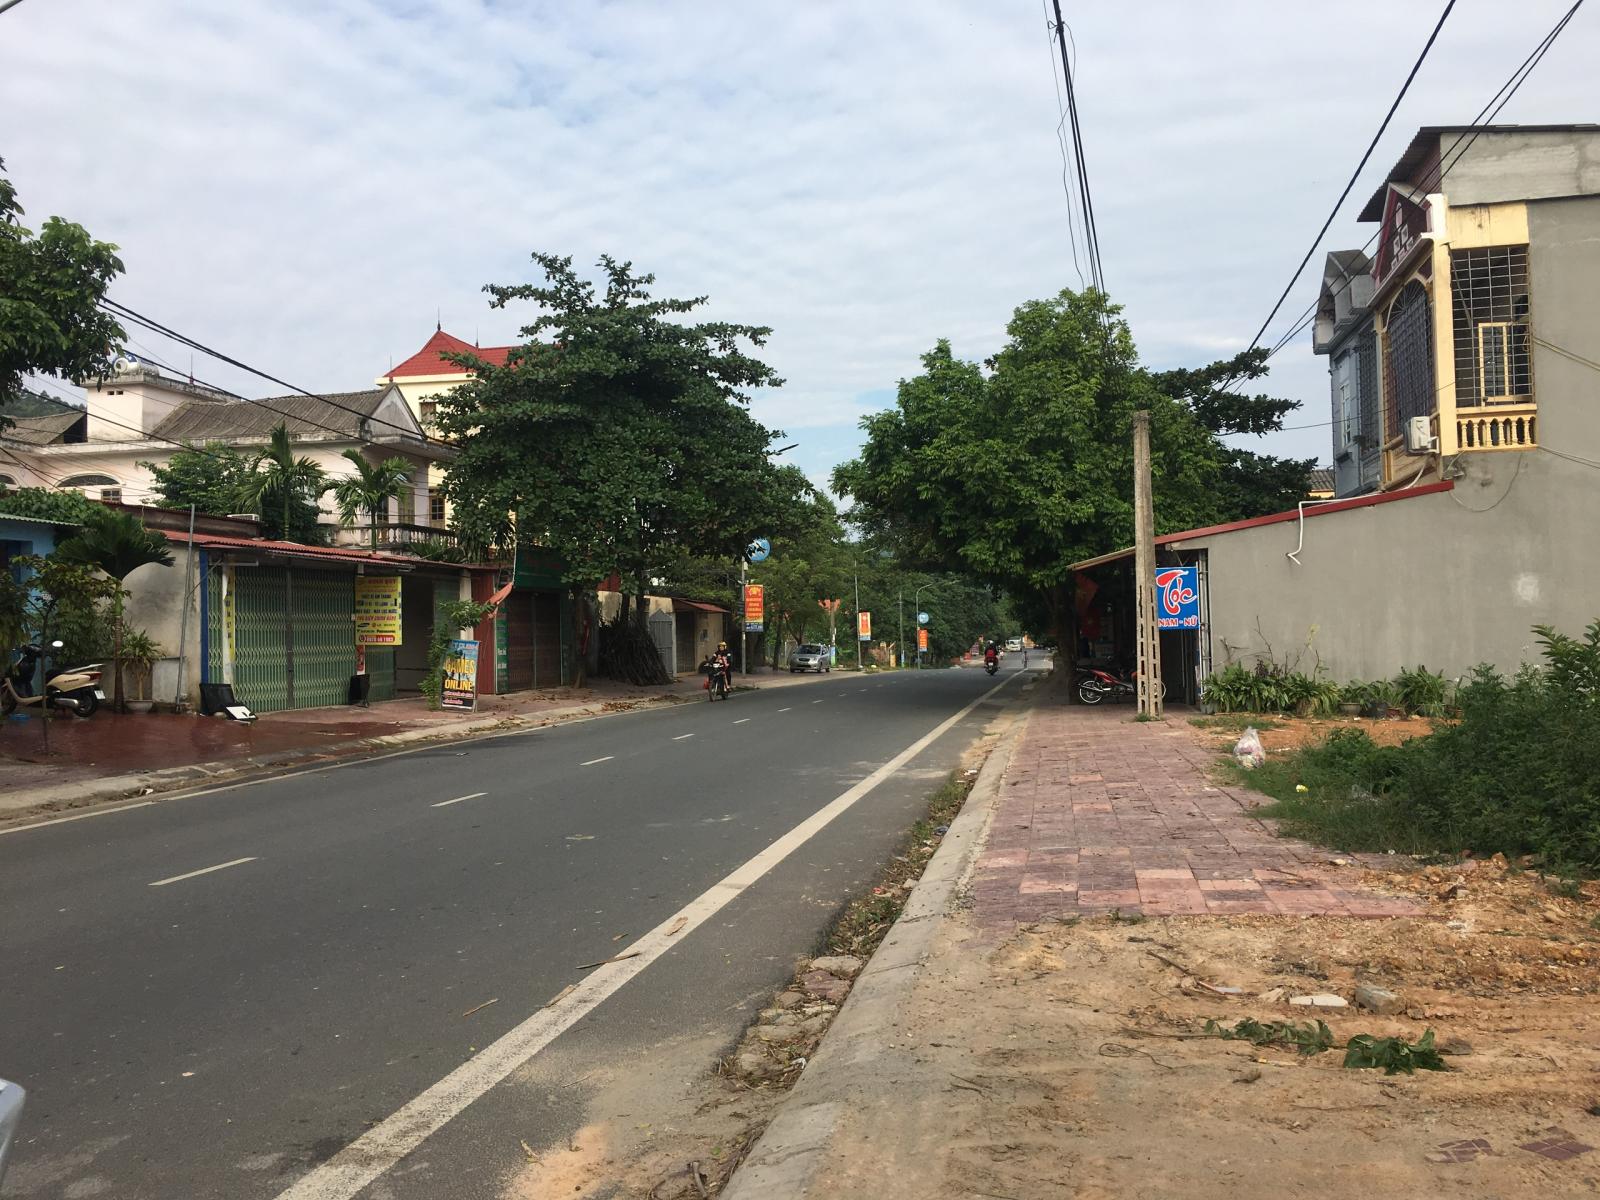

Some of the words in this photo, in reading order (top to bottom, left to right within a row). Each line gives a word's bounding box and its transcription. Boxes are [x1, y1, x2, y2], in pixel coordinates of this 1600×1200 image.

[1156, 570, 1197, 615] Tóc
[1158, 618, 1178, 628] NAM
[1184, 616, 1198, 627] NỮ
[445, 658, 475, 674] GAMES
[444, 679, 473, 691] ONLINE
